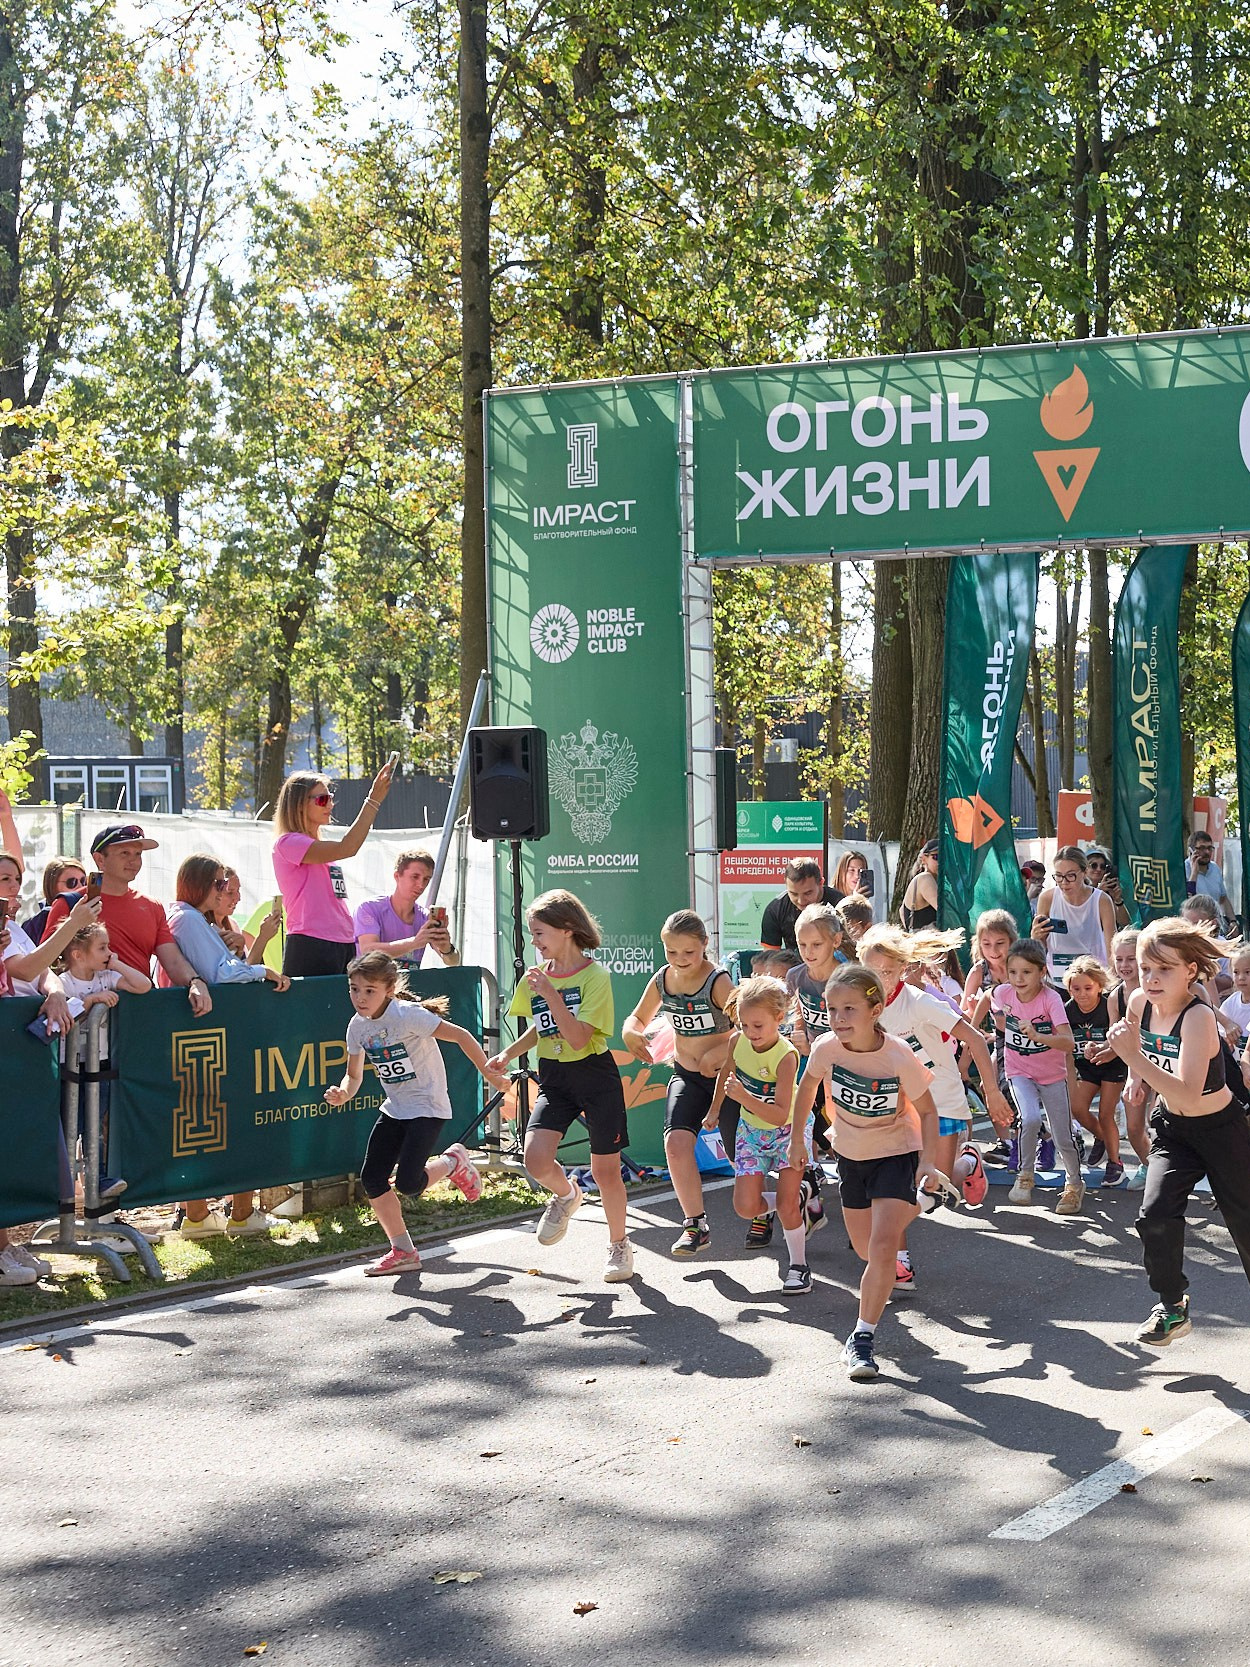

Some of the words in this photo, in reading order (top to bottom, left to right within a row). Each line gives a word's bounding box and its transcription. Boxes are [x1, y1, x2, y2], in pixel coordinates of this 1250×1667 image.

[766, 392, 989, 453] ОГОНЬ
[736, 456, 991, 521] ЖИЗНИ
[533, 500, 636, 528] IMPACT
[533, 527, 613, 541] БЛАГОТВОРИТЕЛЬНЫЙ
[614, 526, 637, 535] ФОНД
[587, 608, 635, 623] NOBLE
[587, 622, 645, 638] IMPACT
[588, 639, 627, 653] CLUB
[1130, 626, 1155, 831] IMPACT
[547, 854, 585, 867] ФМБА
[588, 854, 639, 866] РОССИИ
[724, 857, 767, 865] ПЕШЕХОД!
[769, 857, 780, 865] НЕ
[724, 867, 734, 875] ЗА
[737, 867, 774, 876] ПРЕДЕЛЫ
[673, 1015, 704, 1029] 881
[841, 1088, 888, 1109] 882
